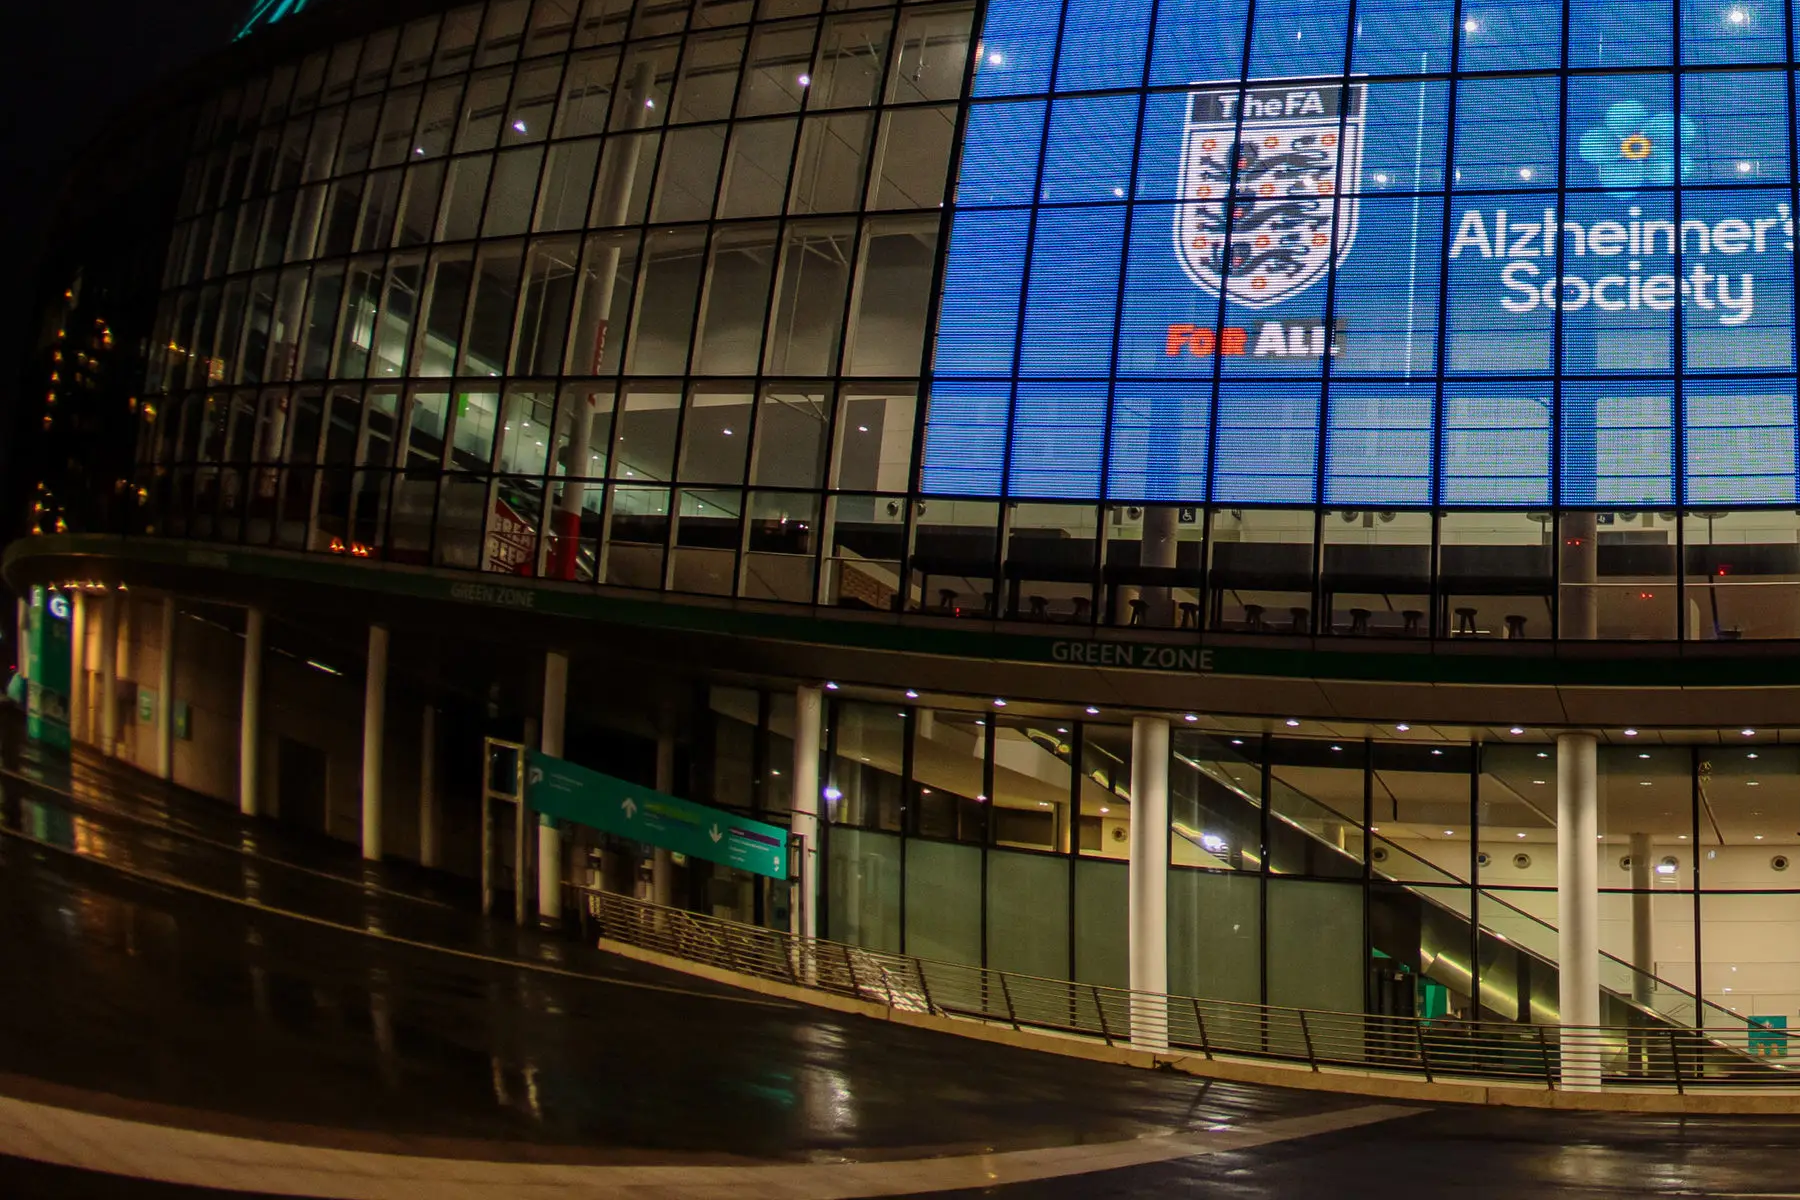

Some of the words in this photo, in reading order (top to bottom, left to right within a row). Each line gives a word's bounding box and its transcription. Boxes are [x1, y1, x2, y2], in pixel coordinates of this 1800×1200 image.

[1500, 260, 1754, 326] Society
[49, 595, 71, 620] G
[450, 582, 493, 601] GREEN
[495, 586, 536, 608] ZONE
[1051, 640, 1134, 666] GREEN
[1141, 646, 1214, 670] ZONE
